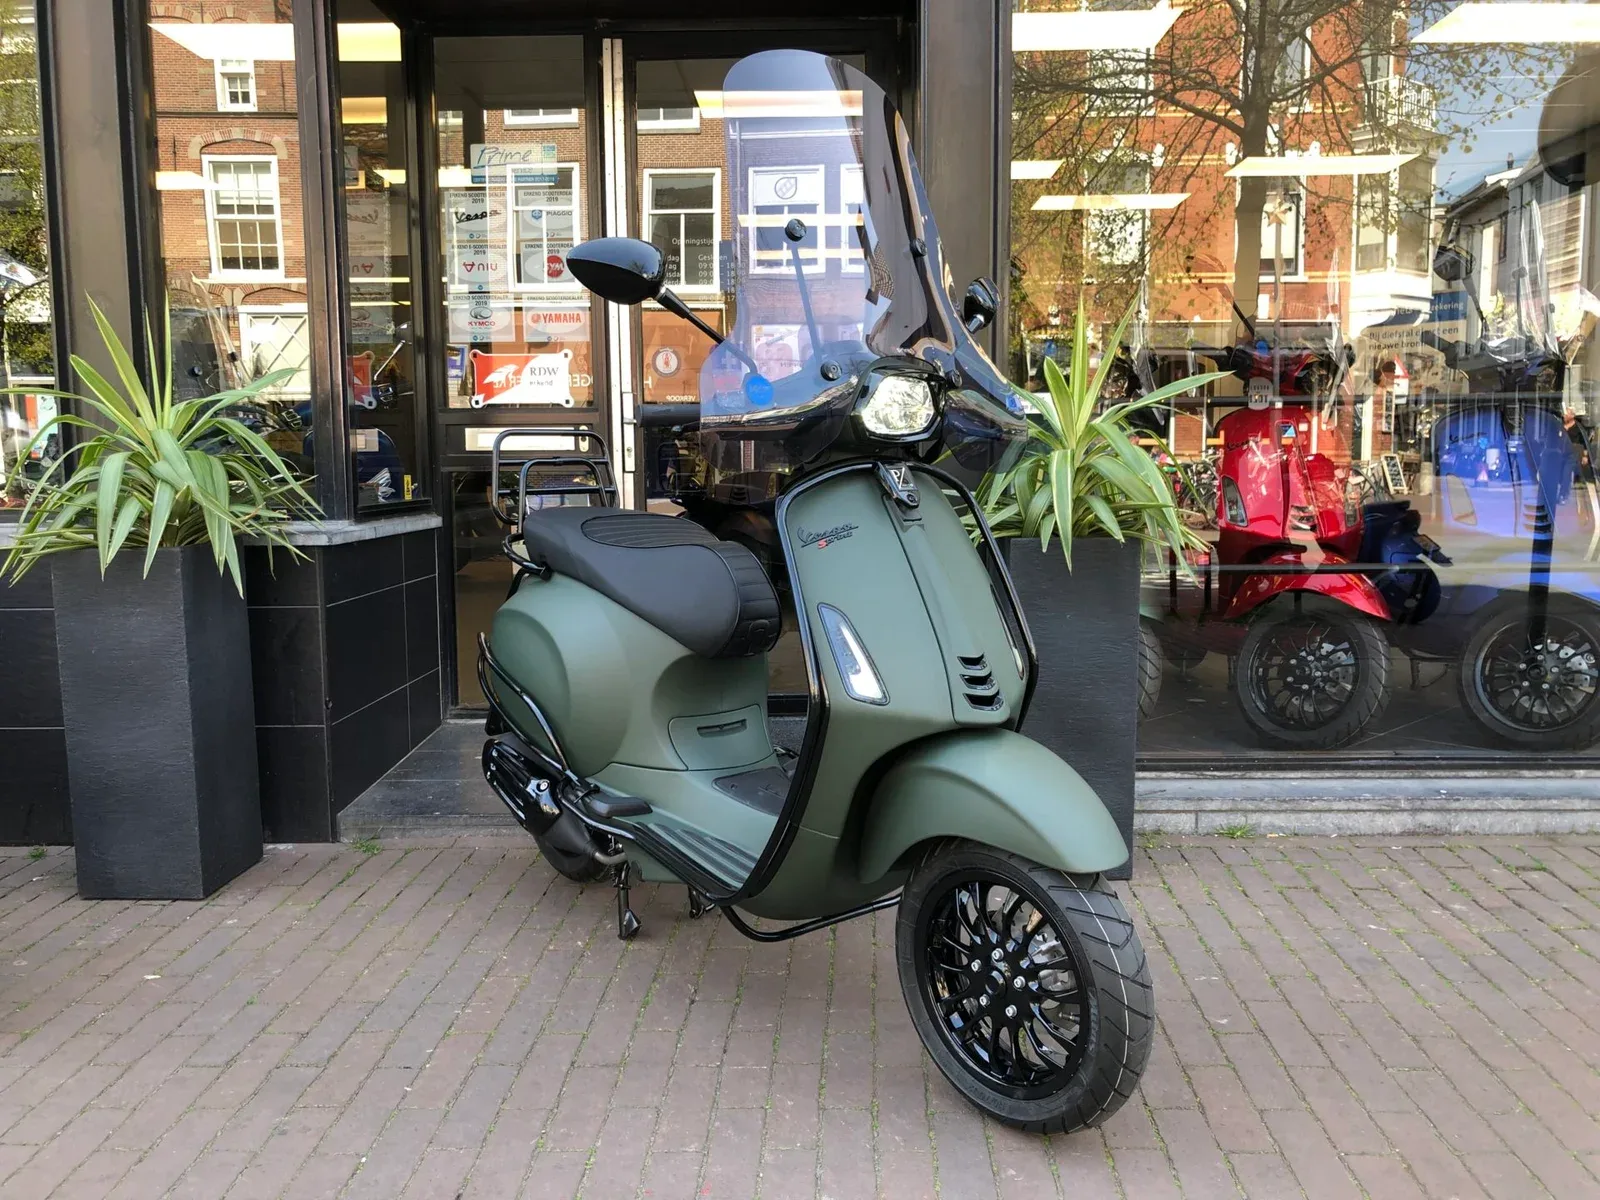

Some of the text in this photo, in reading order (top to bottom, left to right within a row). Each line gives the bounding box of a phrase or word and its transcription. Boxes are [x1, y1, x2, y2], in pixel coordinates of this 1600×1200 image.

[475, 146, 532, 166] Prime
[542, 312, 582, 324] YAMAHA
[1442, 326, 1460, 335] een
[529, 366, 560, 377] RDW
